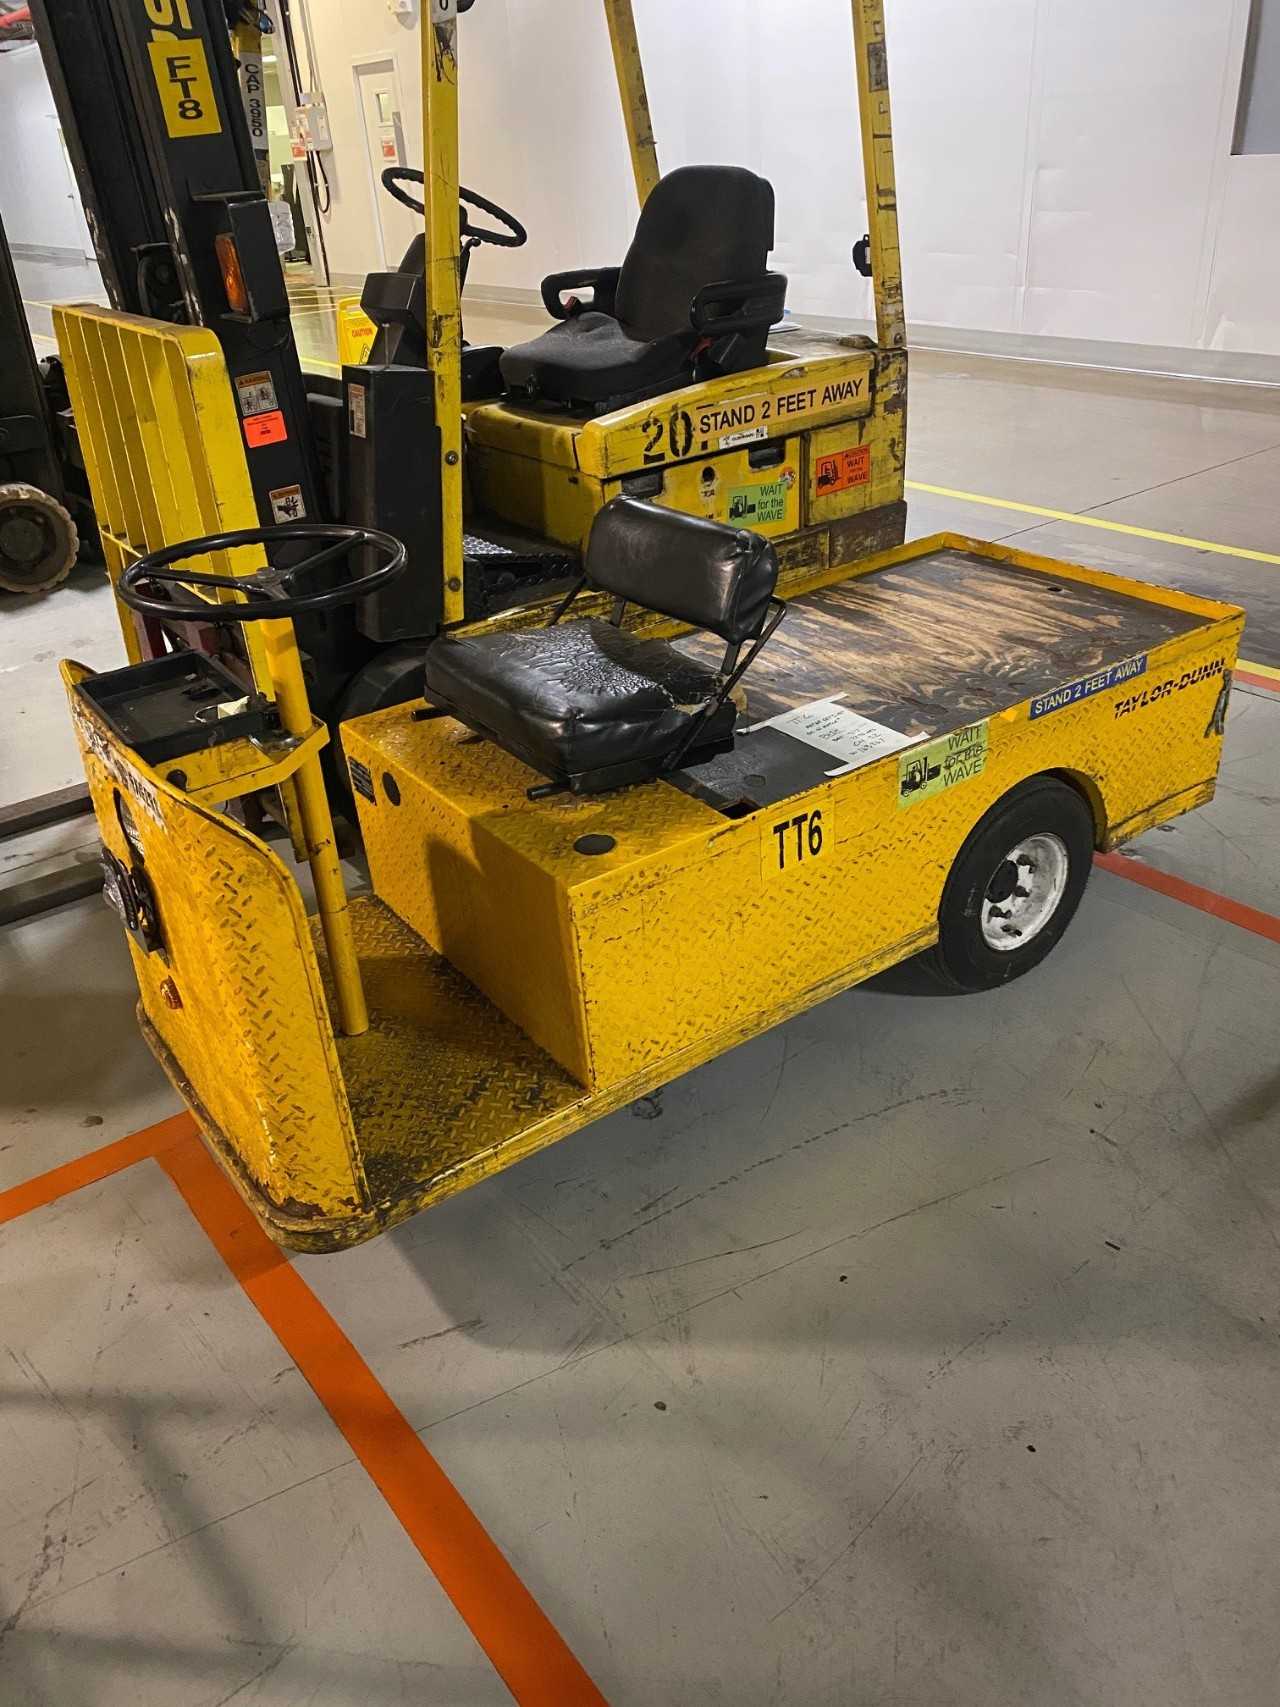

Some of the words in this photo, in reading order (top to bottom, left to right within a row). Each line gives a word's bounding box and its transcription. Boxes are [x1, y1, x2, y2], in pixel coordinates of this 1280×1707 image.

[166, 56, 203, 120] FT8
[244, 63, 260, 93] CAP
[700, 404, 755, 434] STAND
[761, 401, 771, 419] 2
[777, 389, 817, 415] FEET
[821, 378, 863, 405] AWAY
[641, 403, 711, 465] 20
[758, 500, 769, 510] for
[771, 497, 784, 507] the
[760, 483, 784, 496] WAIT
[757, 510, 784, 522] WAVE
[1034, 689, 1072, 714] STAND
[1074, 686, 1081, 698] 2
[1085, 672, 1112, 694] FEET
[1115, 658, 1145, 683] AWAY
[1114, 657, 1225, 720] TAYLOR-DUNN
[947, 724, 983, 751] WAIT
[943, 759, 983, 787] WAVE
[773, 810, 822, 869] TT6
